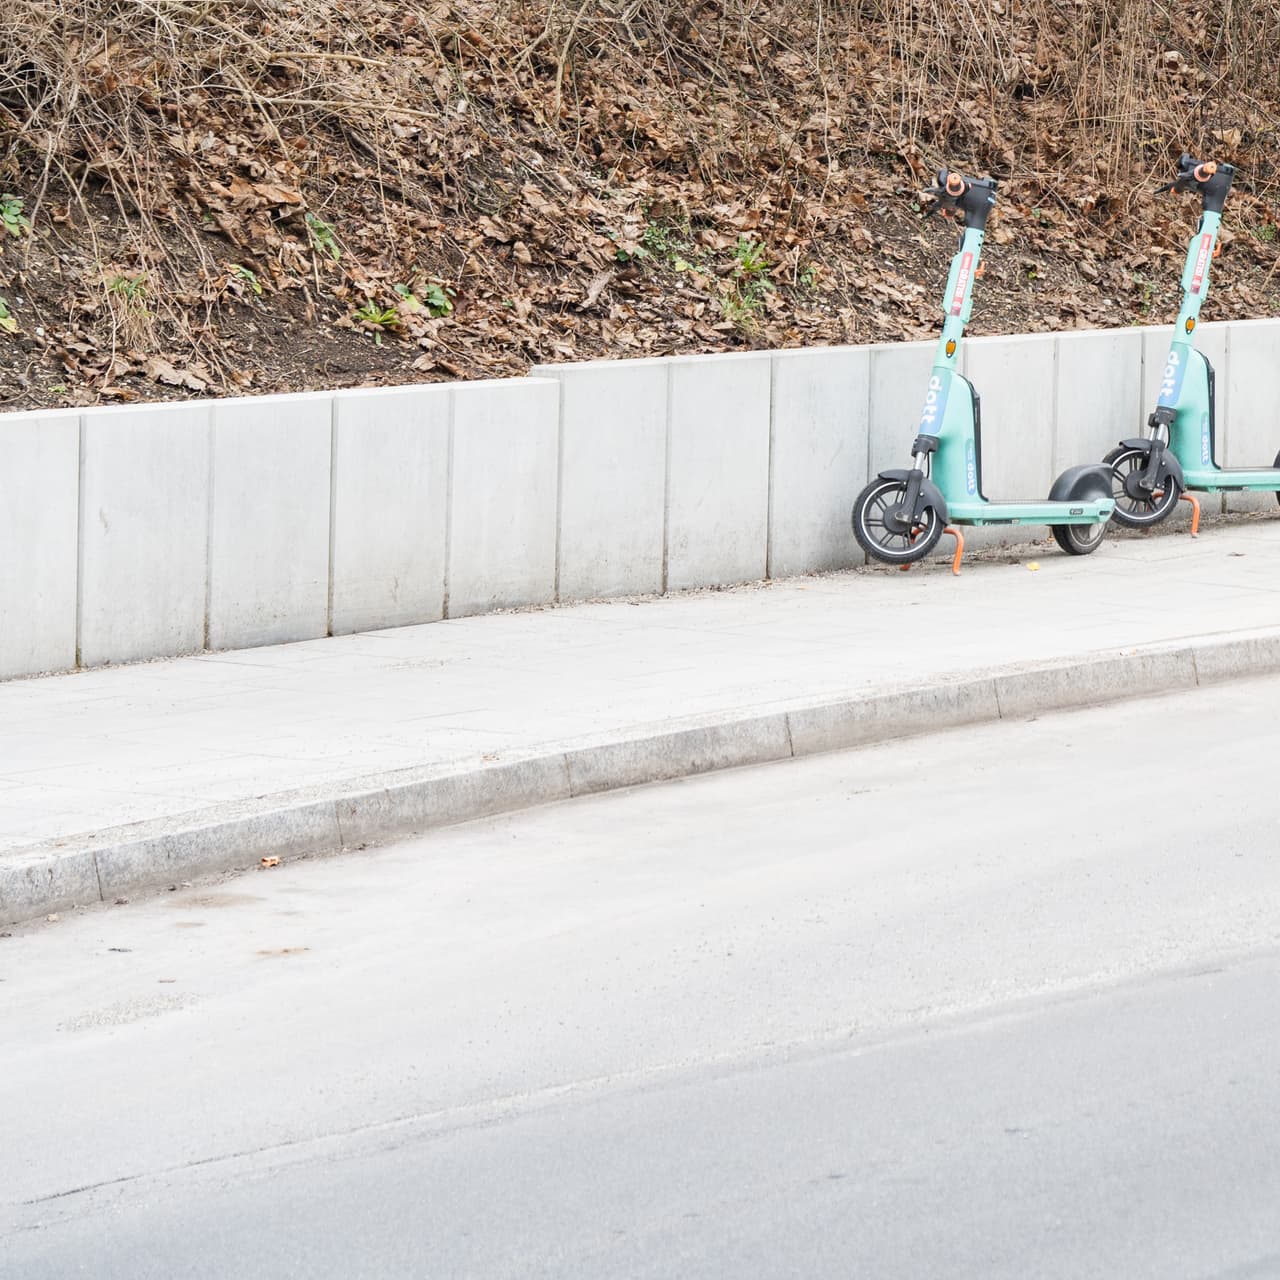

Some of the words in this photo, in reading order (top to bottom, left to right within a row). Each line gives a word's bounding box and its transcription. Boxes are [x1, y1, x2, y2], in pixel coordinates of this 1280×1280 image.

[1159, 351, 1180, 397] dott
[920, 375, 942, 425] dott
[1202, 434, 1210, 464] dott
[967, 463, 976, 492] dott
